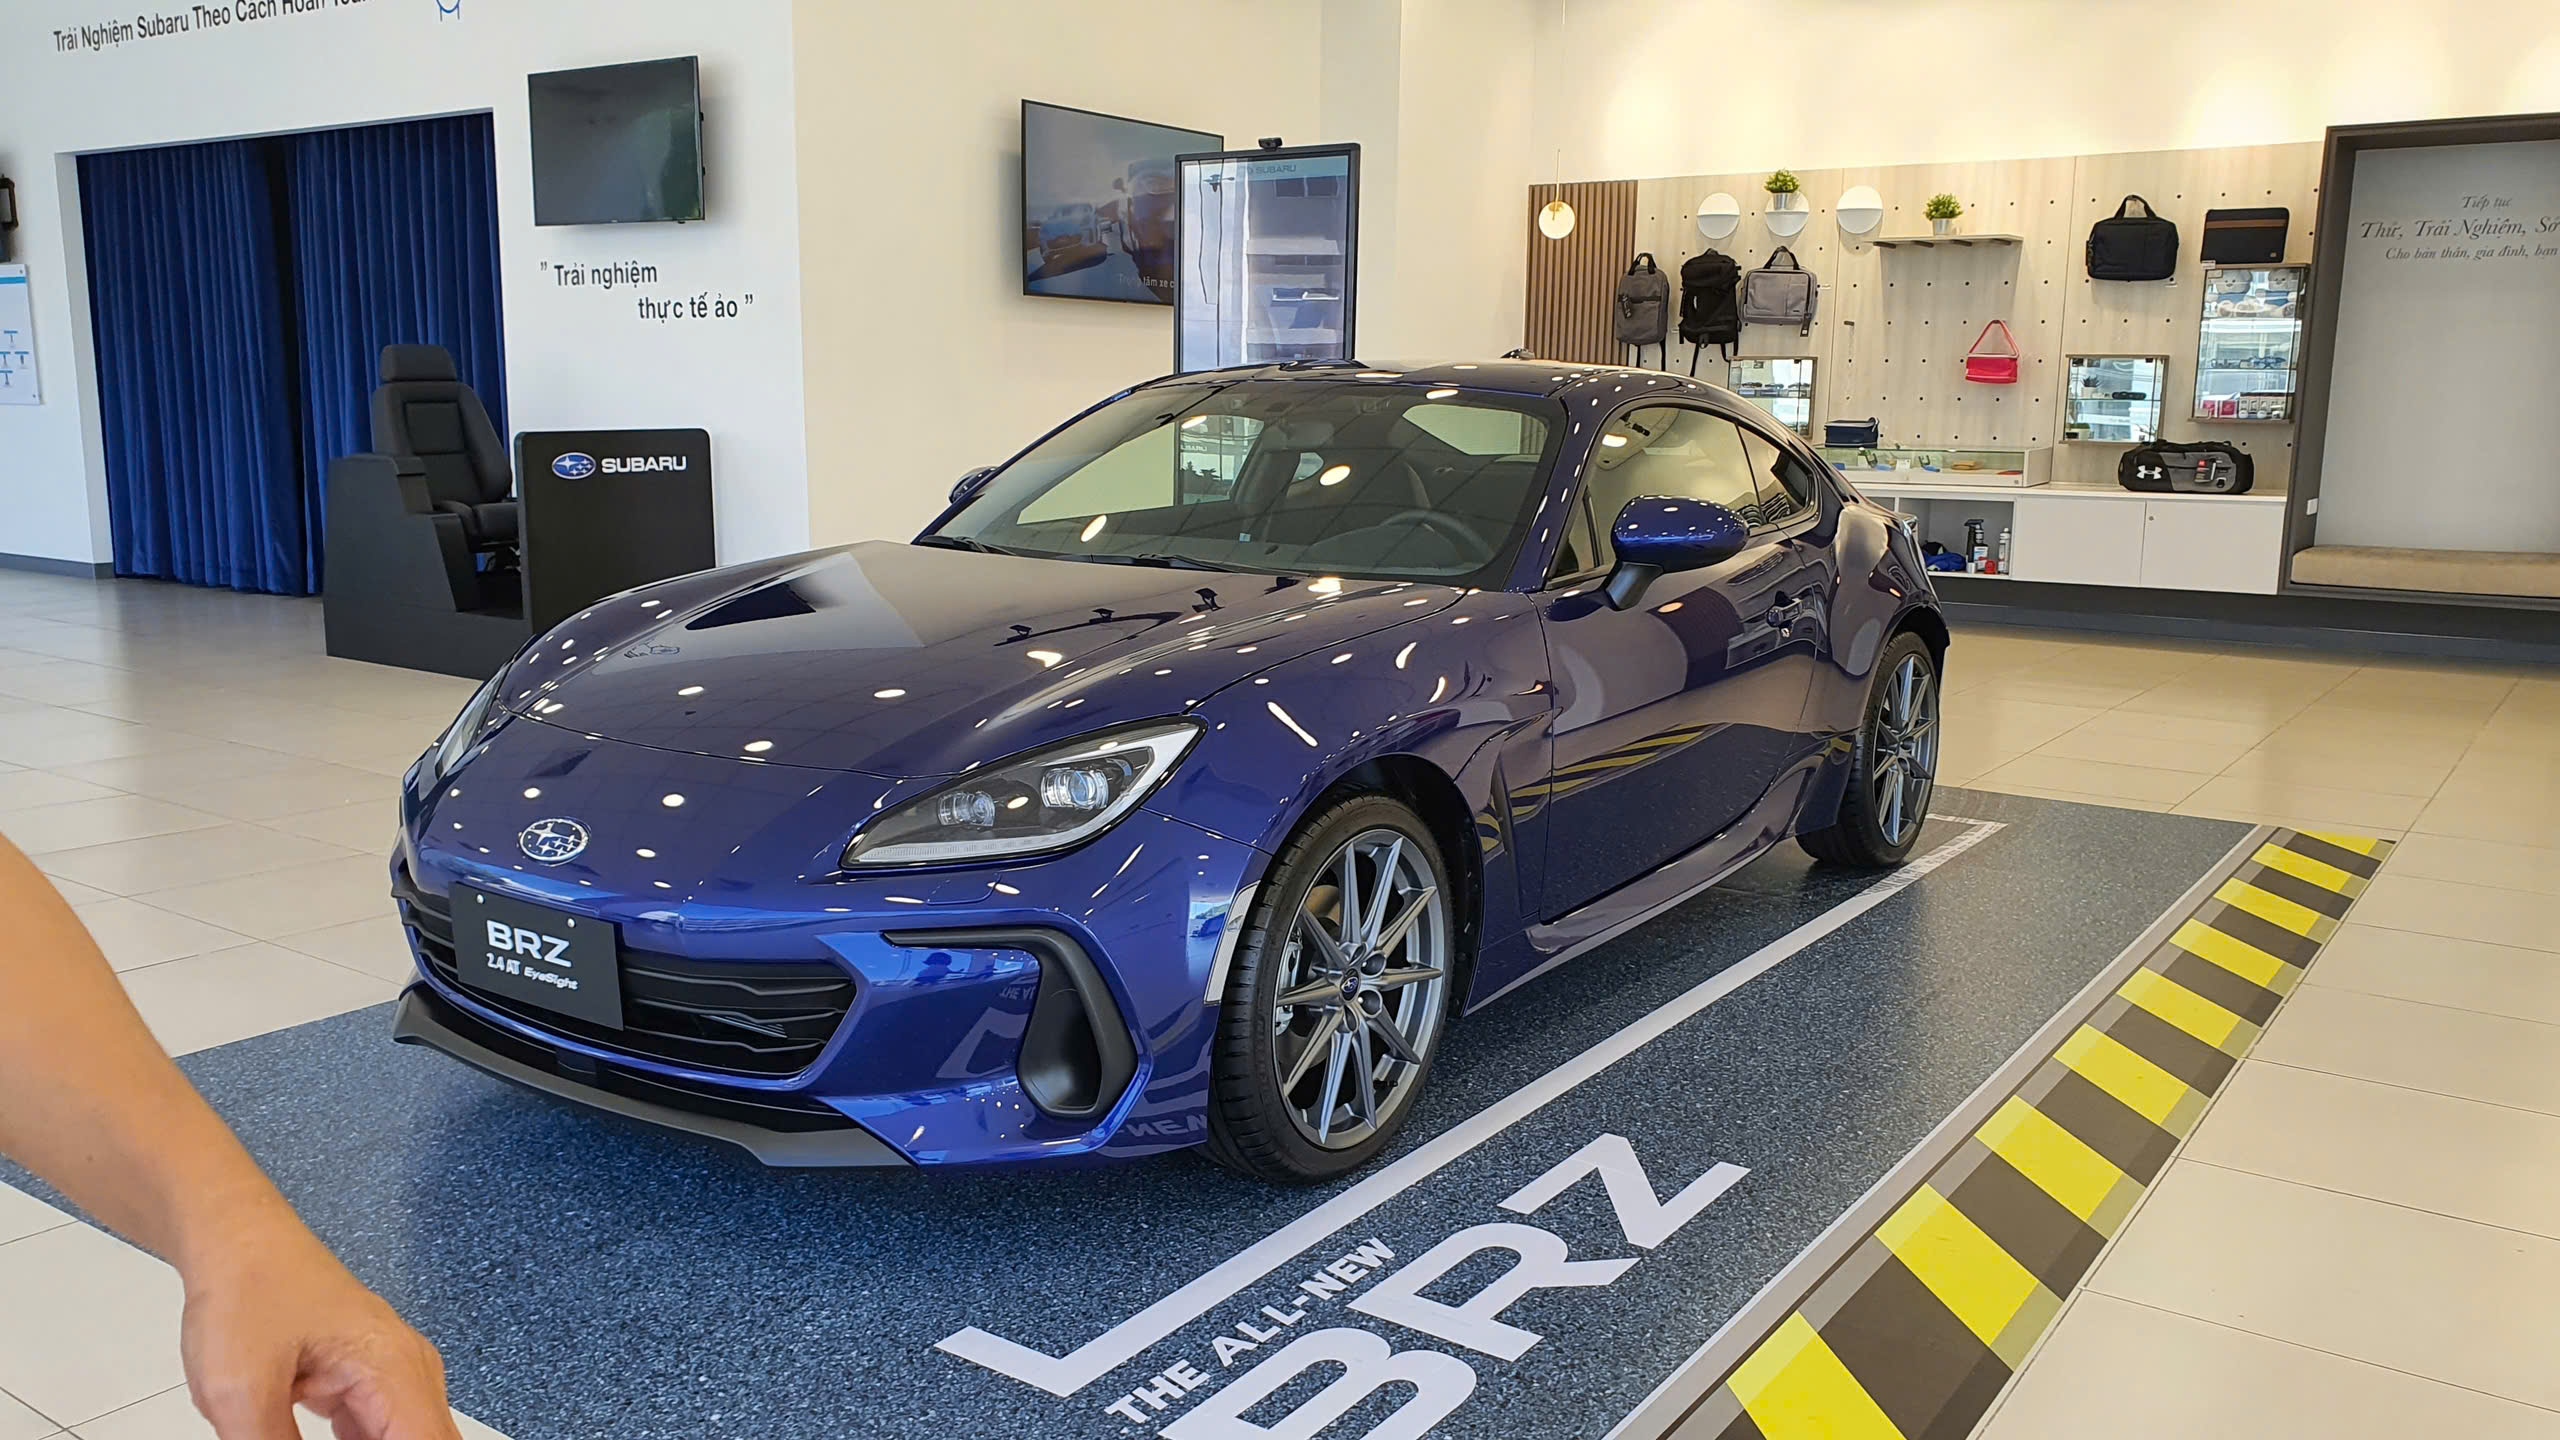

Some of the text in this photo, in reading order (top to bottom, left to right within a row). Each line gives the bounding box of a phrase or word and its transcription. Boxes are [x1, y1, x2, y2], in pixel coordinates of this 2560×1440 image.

[54, 27, 79, 52] Trải
[81, 20, 134, 51] Nghiệm
[137, 14, 189, 39] Subaru
[192, 5, 231, 30] Theo
[1255, 165, 1297, 175] SUBARU
[2385, 247, 2411, 260] Cho
[2473, 246, 2495, 260] gia
[554, 262, 585, 286] Trải
[591, 260, 658, 290] nghiệm
[638, 297, 684, 324] thực
[689, 291, 708, 319] tế
[714, 293, 738, 318] ảo
[601, 456, 687, 474] SUBARU
[486, 919, 573, 968] BRZ
[523, 966, 578, 990] EyeSight
[1157, 1132, 1752, 1440] BRZ
[1104, 1237, 1396, 1424] THE ALL-NEW
